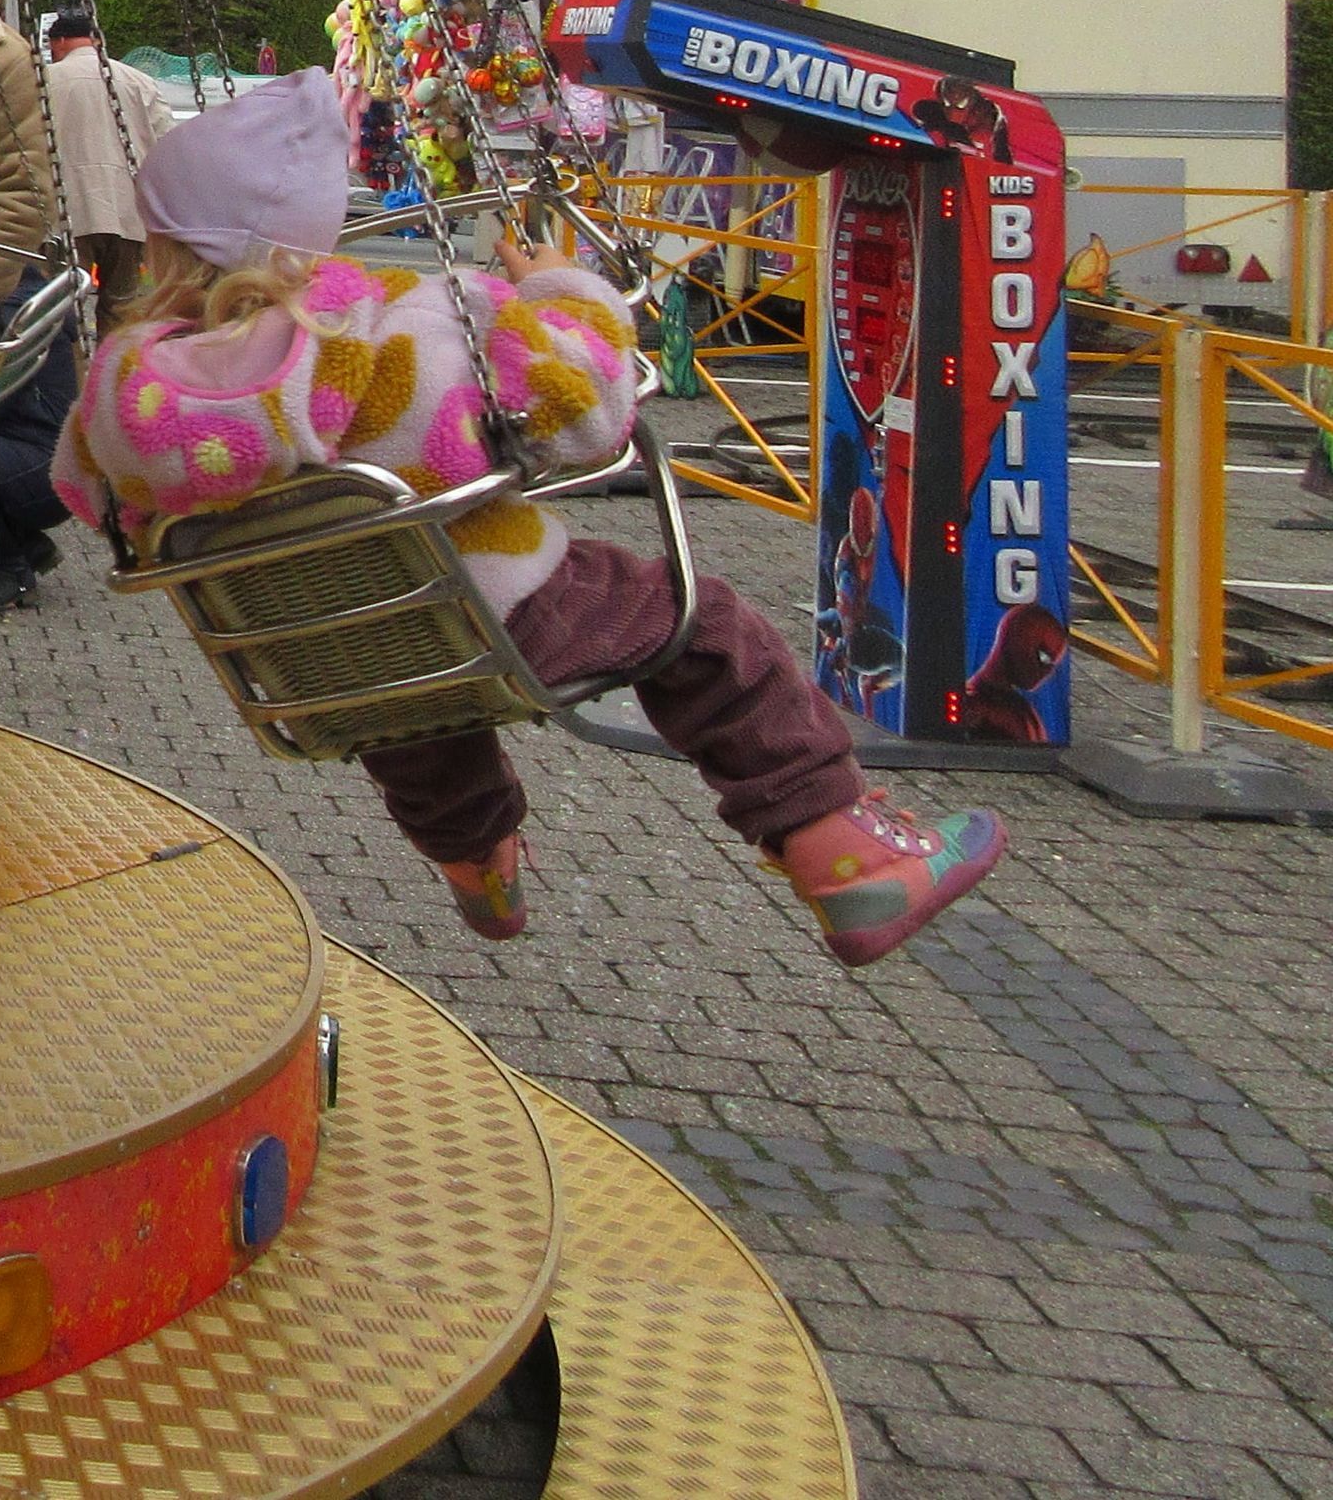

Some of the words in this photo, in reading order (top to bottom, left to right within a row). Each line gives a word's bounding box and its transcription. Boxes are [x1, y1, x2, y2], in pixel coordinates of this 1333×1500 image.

[564, 6, 616, 35] BOXING
[683, 26, 704, 67] KIDS
[696, 29, 901, 118] BOXING
[989, 175, 1035, 196] KIDS
[990, 204, 1042, 606] BOXING
